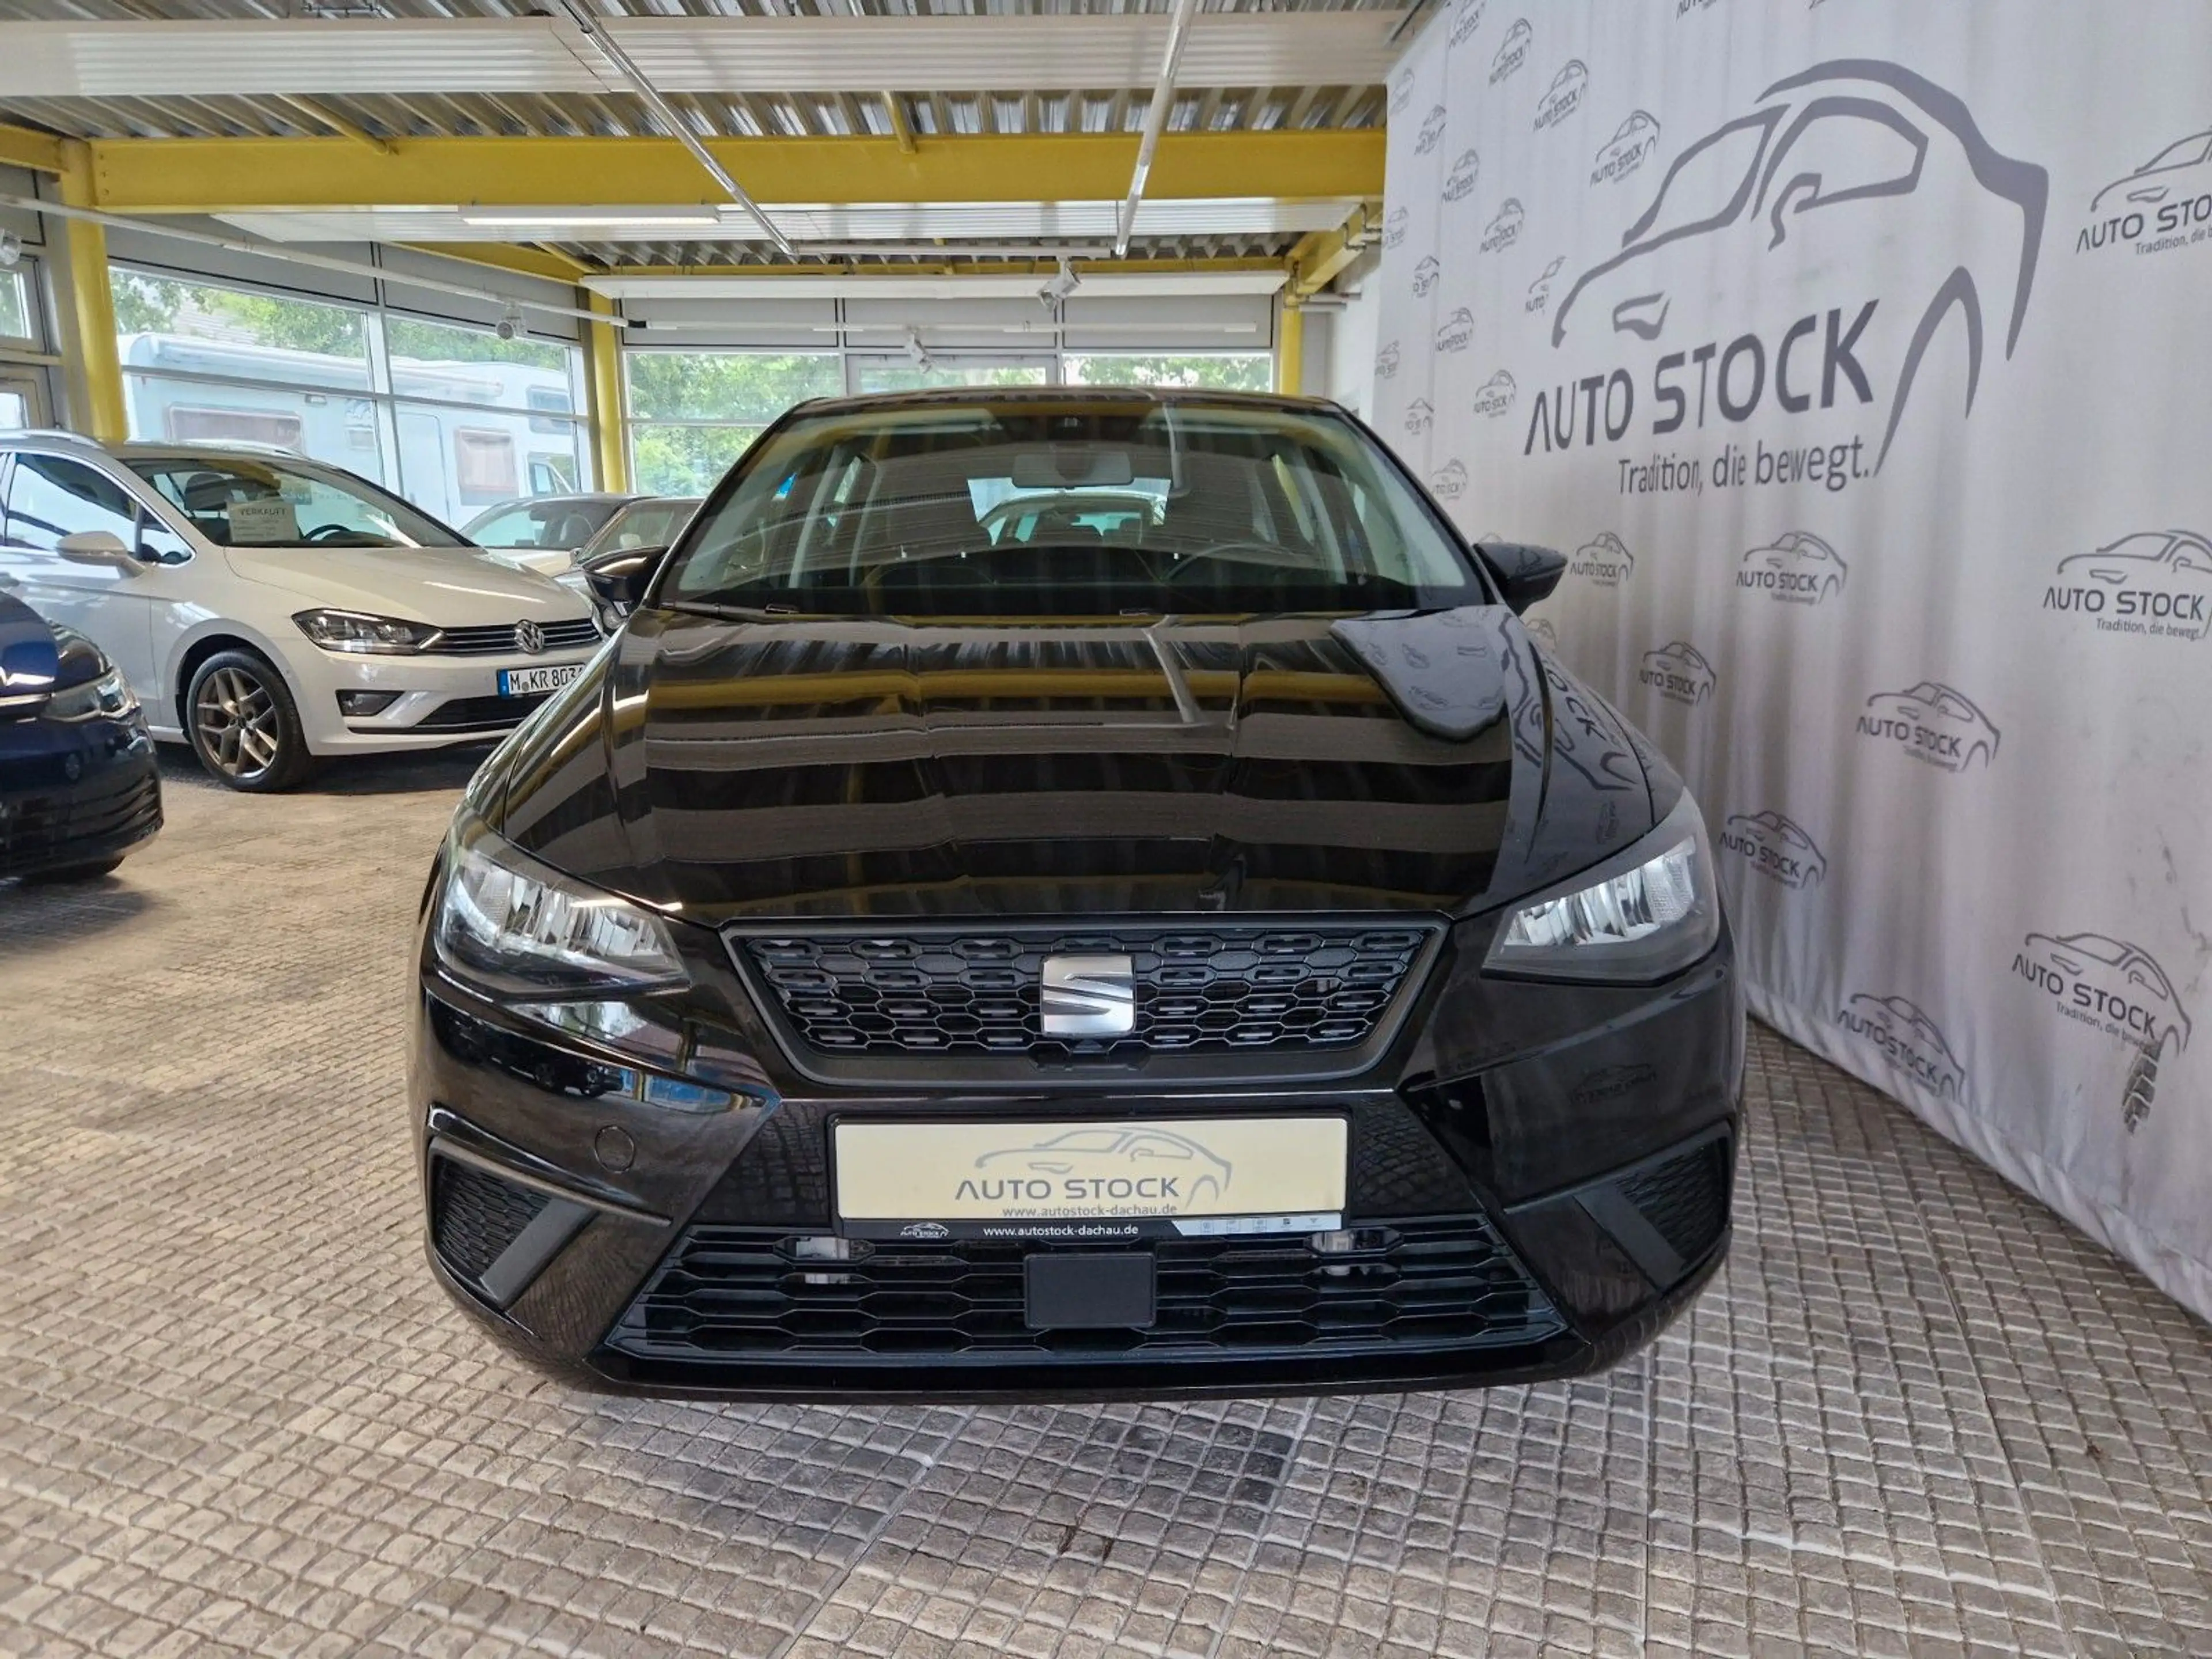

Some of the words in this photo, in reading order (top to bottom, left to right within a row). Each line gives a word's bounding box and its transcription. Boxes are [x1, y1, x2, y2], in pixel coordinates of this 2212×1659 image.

[2076, 213, 2144, 255] AUTO
[1524, 368, 1634, 456] AUTO
[1653, 298, 1880, 435] STOCK
[1619, 453, 1702, 497] Tradition,
[1713, 444, 1745, 487] die
[1755, 434, 1869, 493] bewegt.
[1736, 570, 1775, 588] AUTO
[1778, 572, 1819, 592] STOCK
[2043, 586, 2105, 612] AUTO
[2116, 590, 2205, 621] STOCK
[2096, 617, 2146, 634] Tradition,
[2149, 622, 2165, 635] die
[510, 673, 521, 691] M
[529, 671, 549, 688] KR
[551, 667, 583, 687] 803
[1856, 716, 1910, 741] AUTO
[1914, 725, 1962, 759] STOCK
[1719, 831, 1755, 857] AUTO
[2012, 954, 2063, 995] AUTO
[2073, 982, 2157, 1040] STOCK
[1837, 1010, 1887, 1046] AUTO
[1887, 1036, 1937, 1085] STOCK
[955, 1180, 1052, 1200] AUTO
[1064, 1177, 1180, 1199] STOCK
[1002, 1204, 1177, 1218] www.autostock-dachau.de
[983, 1224, 1139, 1237] www.autostock-dachau.de
